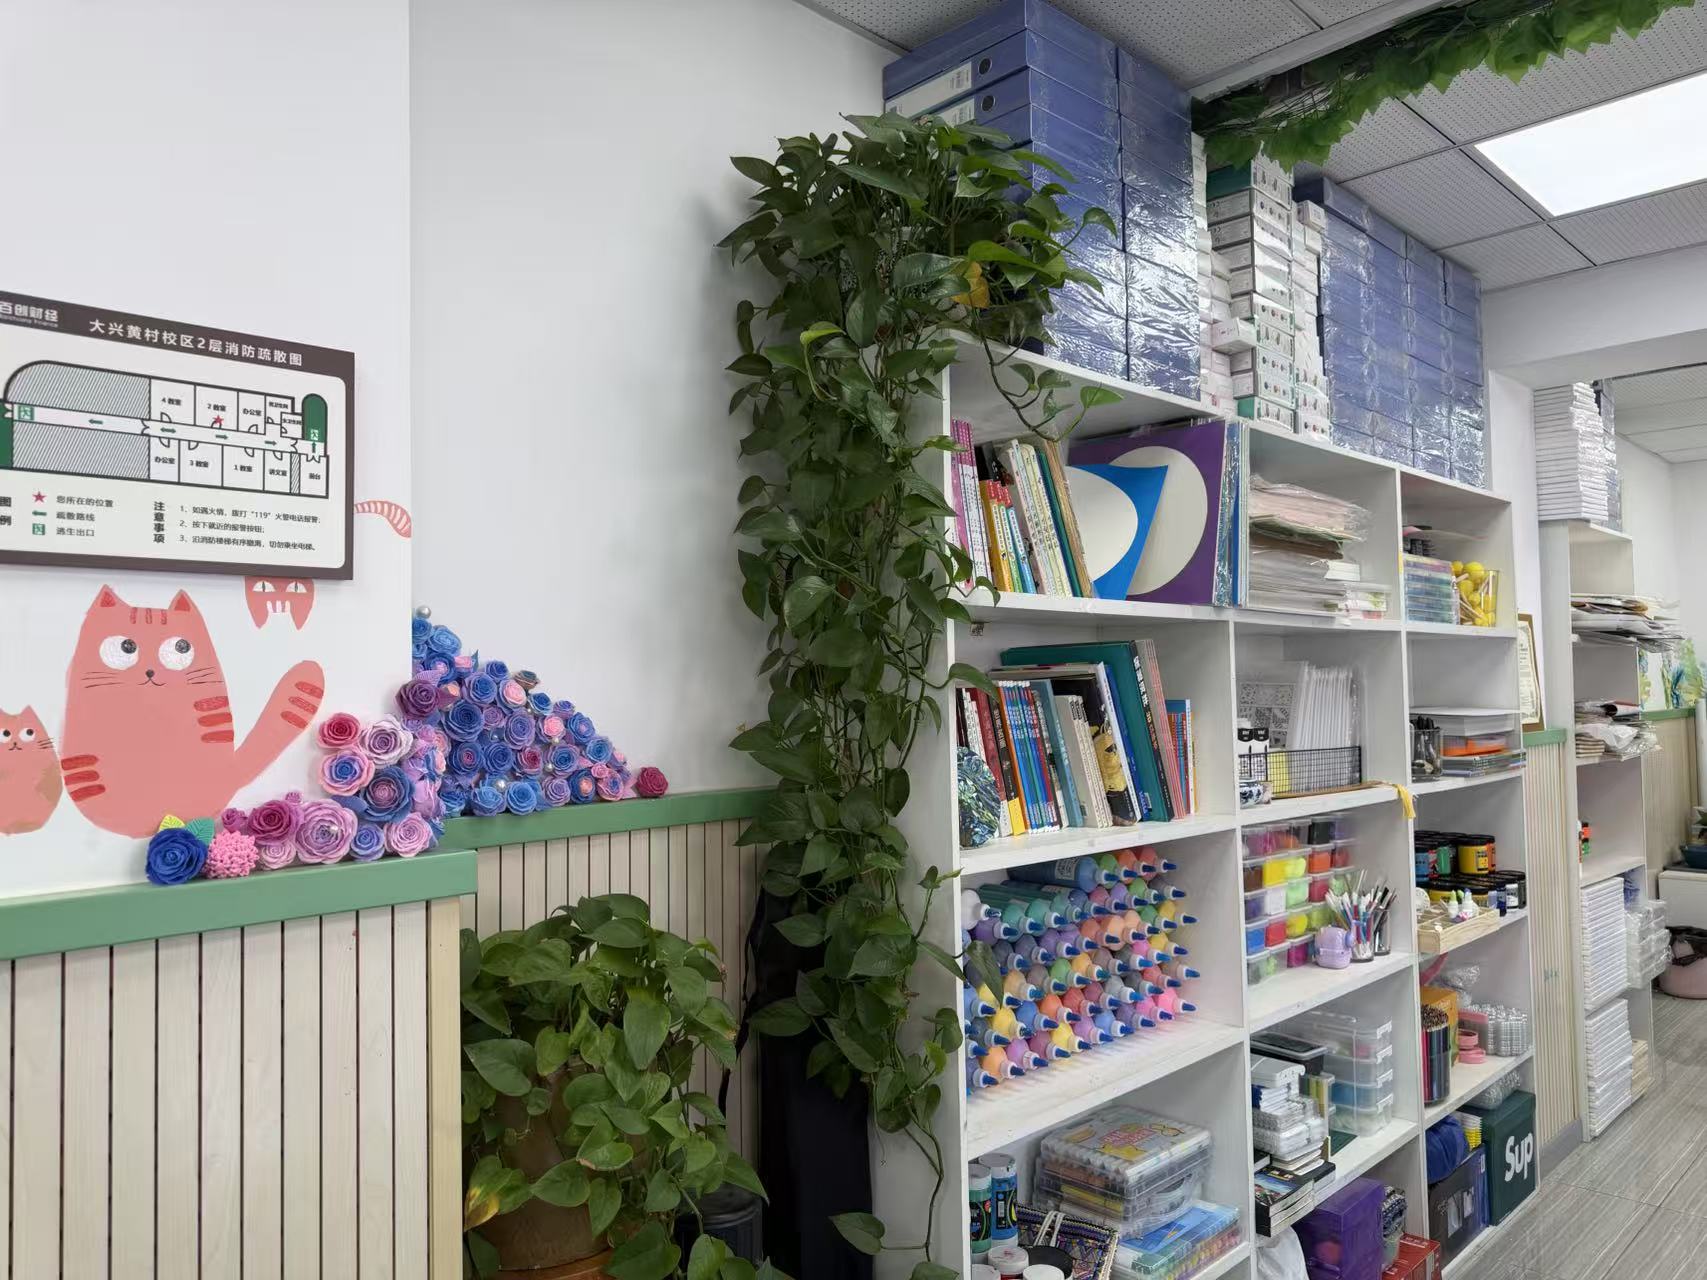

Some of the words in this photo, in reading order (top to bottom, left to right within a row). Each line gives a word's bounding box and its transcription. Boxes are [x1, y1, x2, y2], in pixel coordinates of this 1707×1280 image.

[89, 318, 303, 367] 大兴黄村校区2层消防疏散图
[242, 407, 262, 417] 办公室
[154, 455, 176, 465] 办公室
[55, 494, 114, 508] 您所在的位置
[56, 511, 96, 522] 疏散路线
[153, 501, 166, 544] 注意事项
[56, 526, 95, 537] 逃生出口
